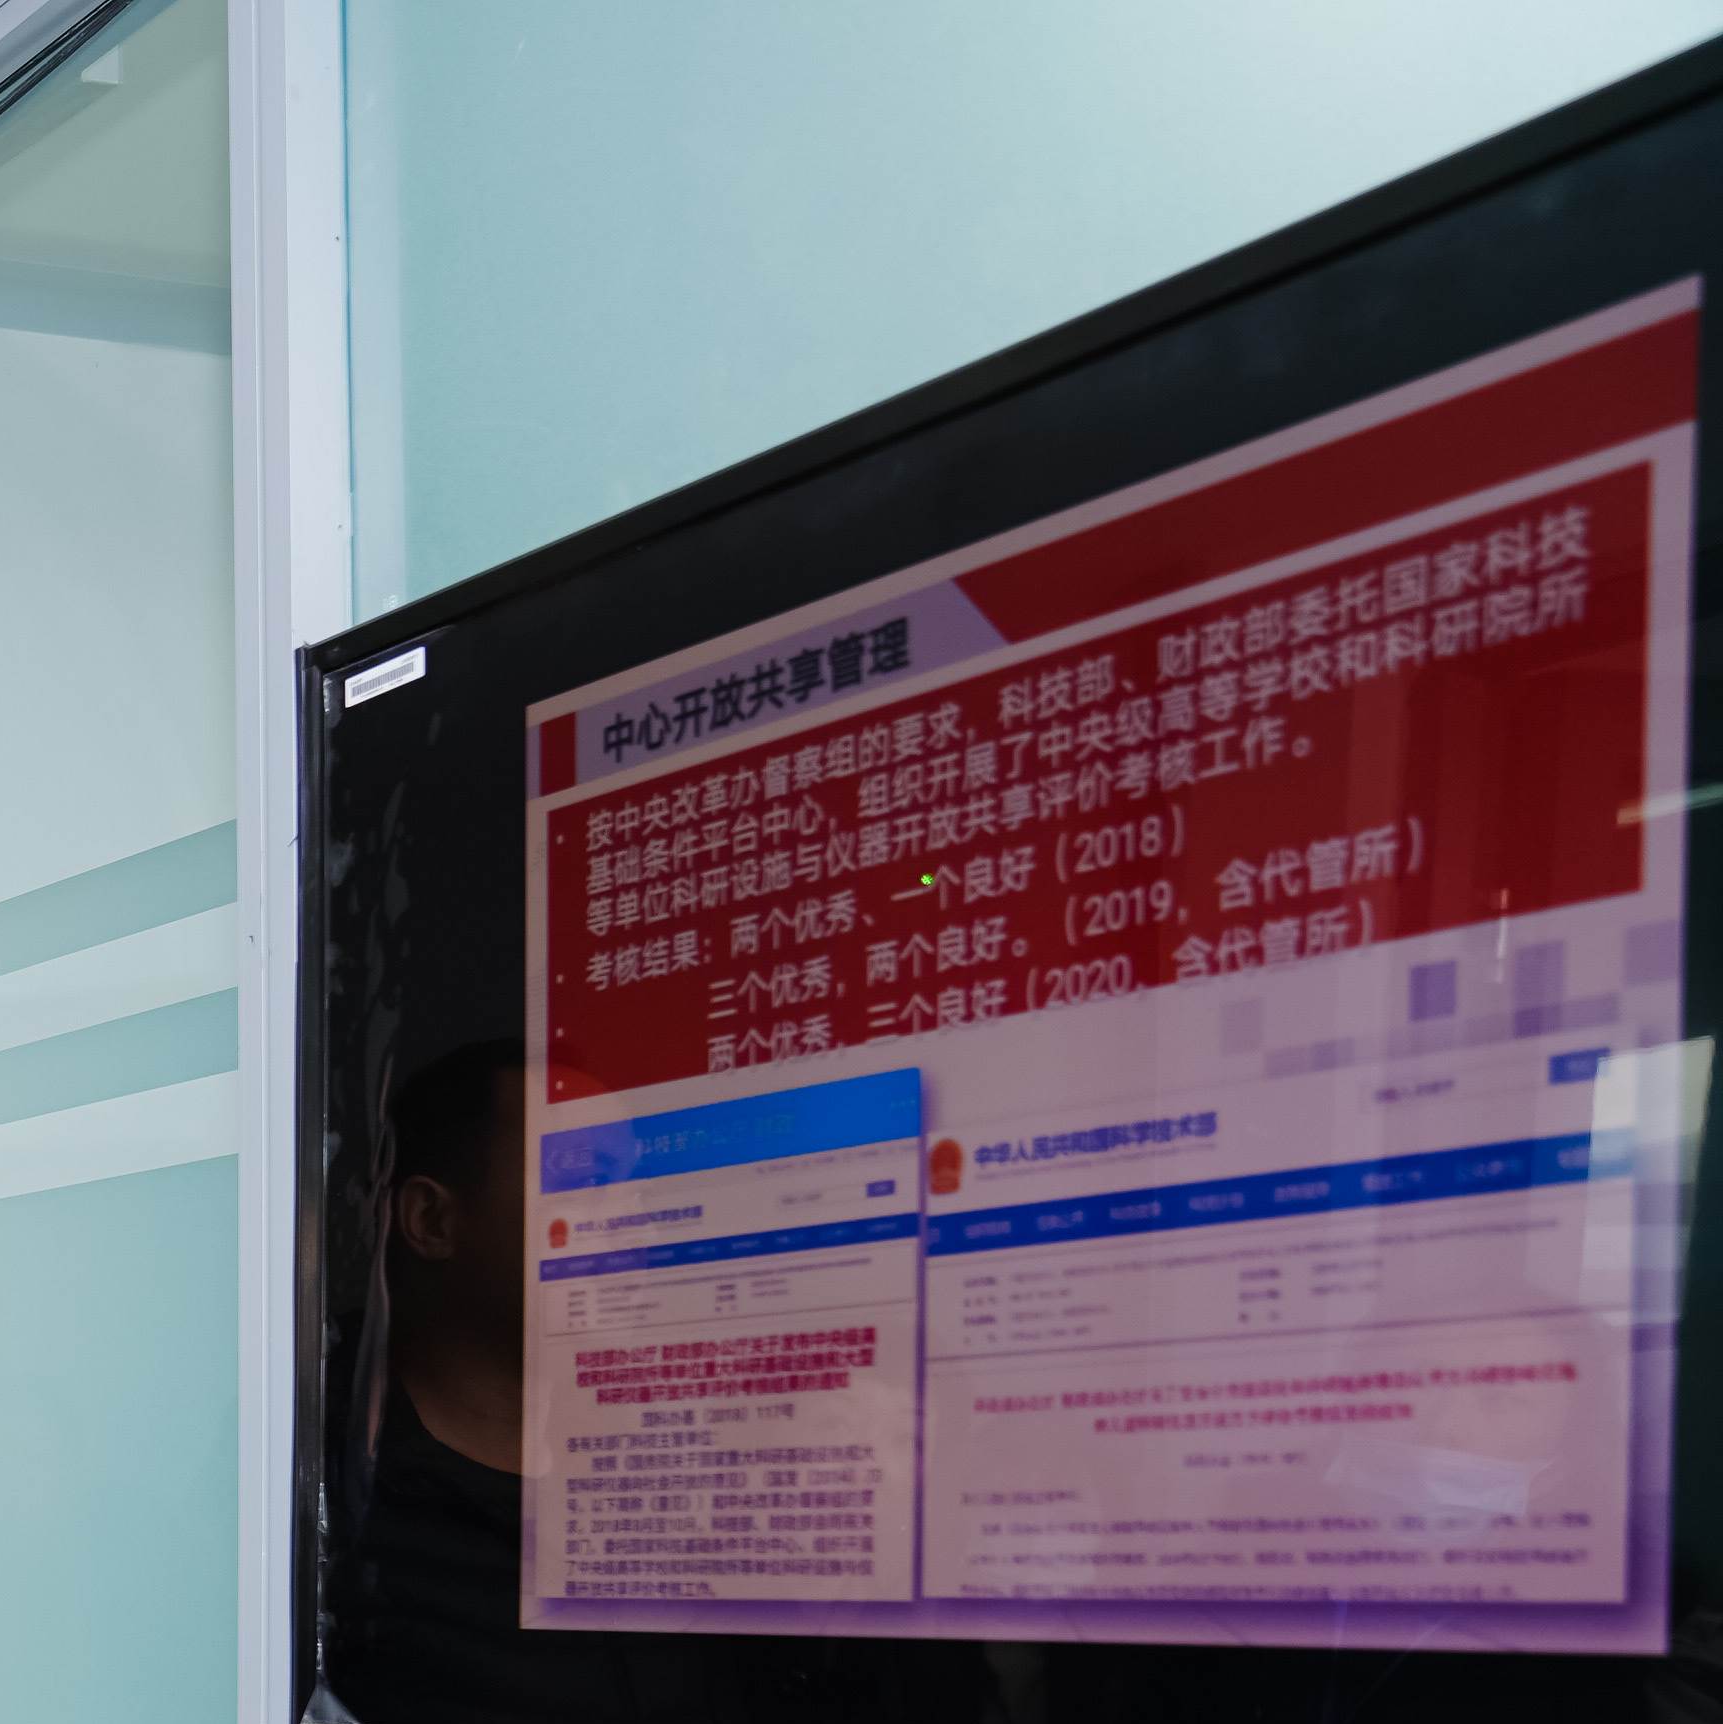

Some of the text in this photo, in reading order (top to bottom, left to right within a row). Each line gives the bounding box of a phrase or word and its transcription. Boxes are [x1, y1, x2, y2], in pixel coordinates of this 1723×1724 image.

[602, 616, 910, 763] 中心开放共享管理
